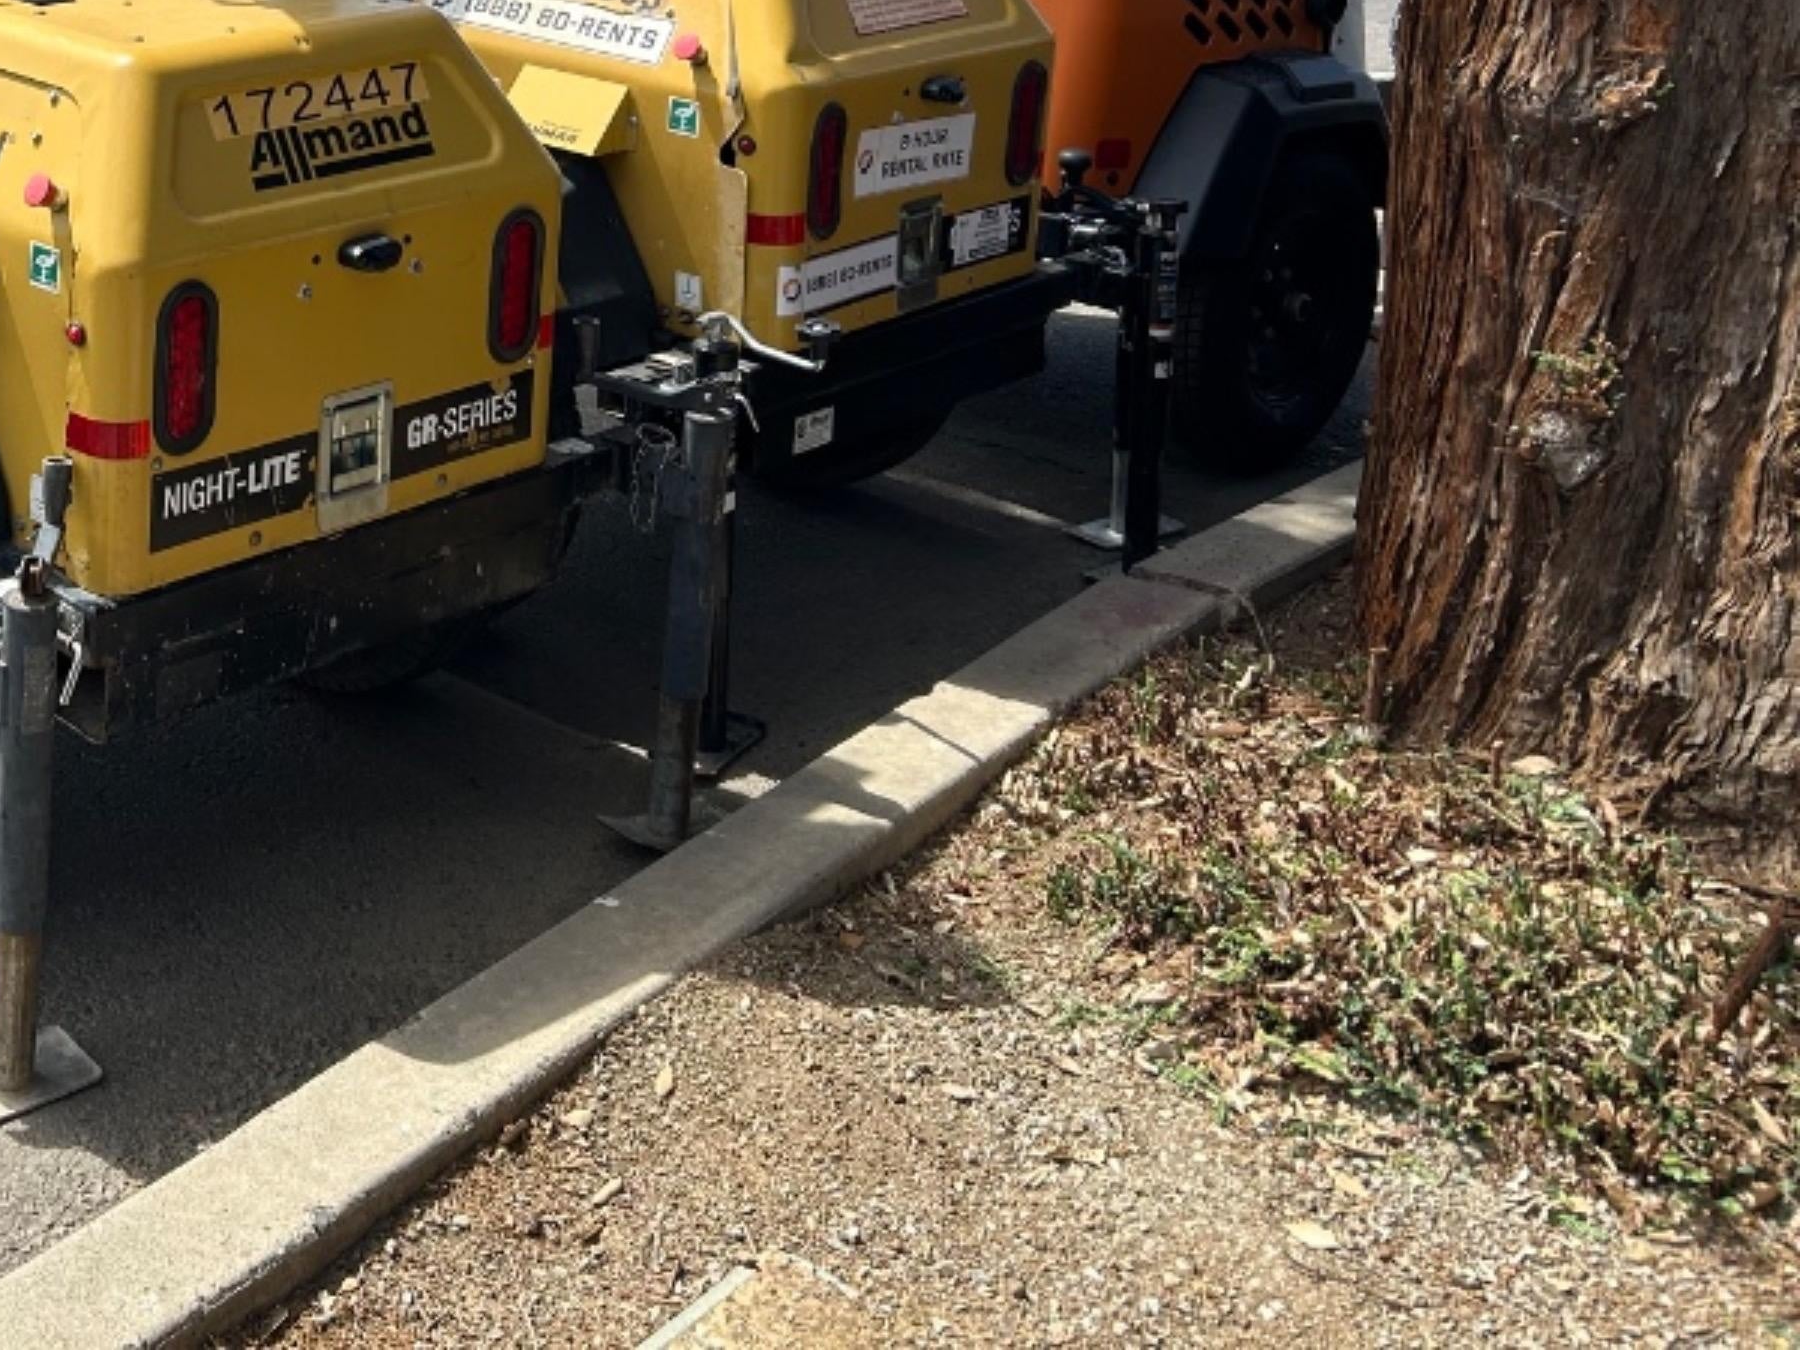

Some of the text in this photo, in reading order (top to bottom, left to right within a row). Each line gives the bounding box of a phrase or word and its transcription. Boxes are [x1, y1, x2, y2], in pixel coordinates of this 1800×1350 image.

[213, 62, 417, 136] 172447
[251, 102, 430, 184] Allmand
[881, 156, 928, 179] RENTAL
[406, 389, 517, 450] GR-SERIES
[162, 451, 302, 519] NIGHT-LITE
